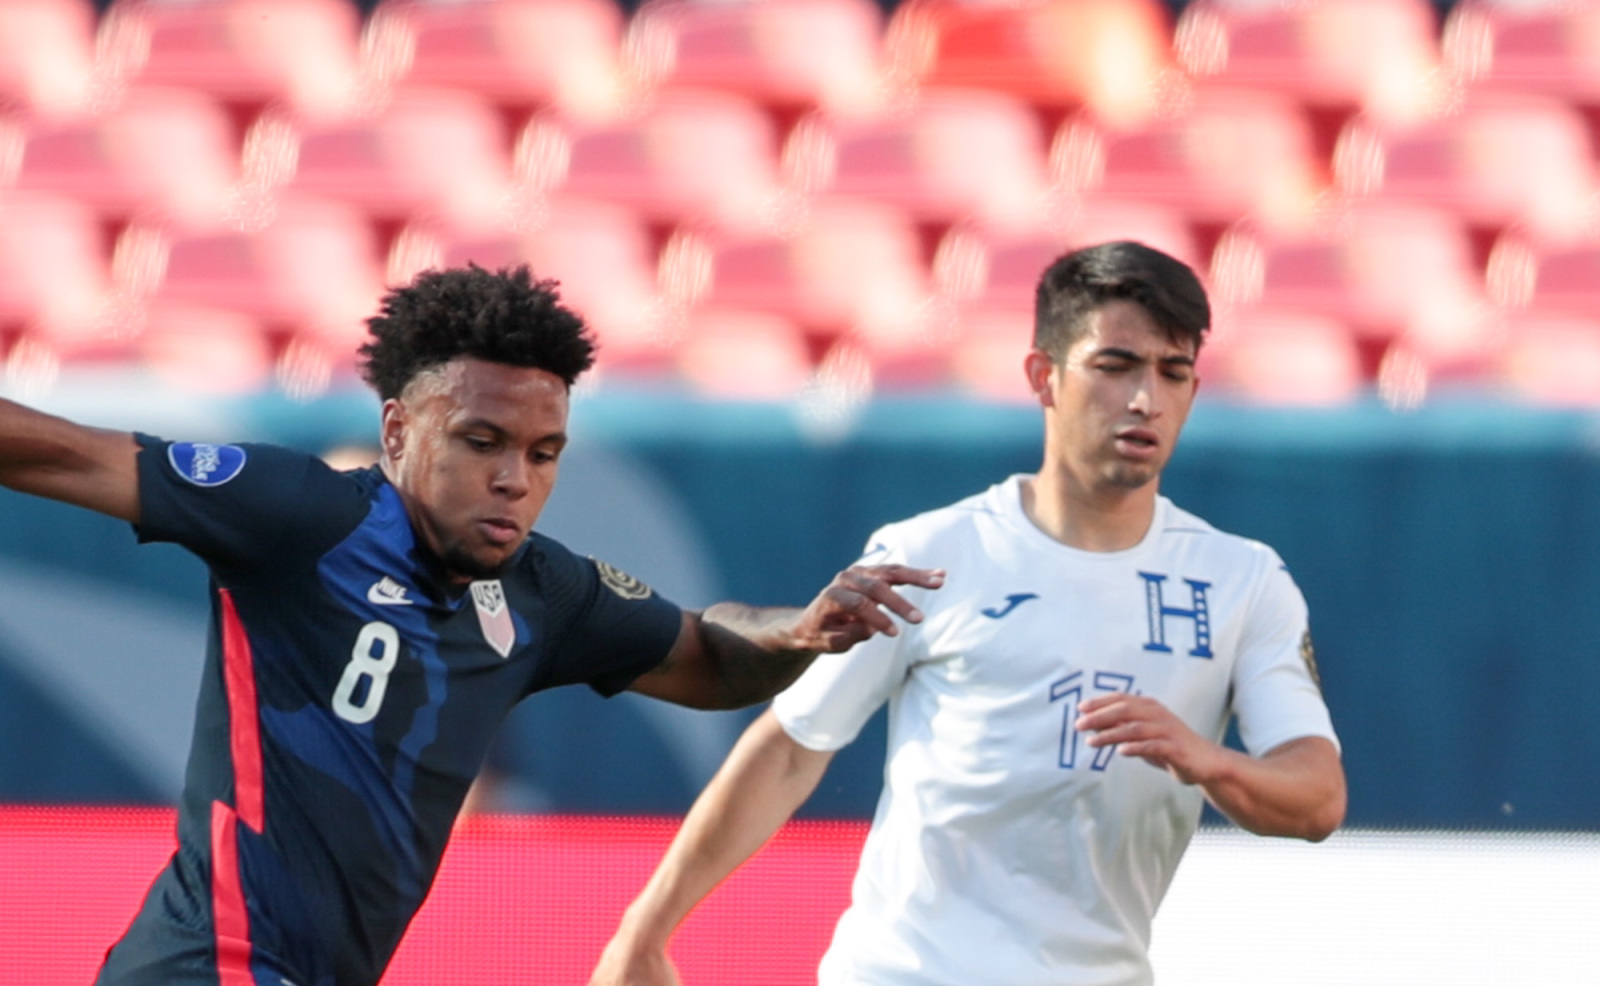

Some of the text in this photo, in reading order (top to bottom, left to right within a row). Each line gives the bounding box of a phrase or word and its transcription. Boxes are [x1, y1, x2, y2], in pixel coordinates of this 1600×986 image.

[473, 583, 502, 612] USA
[1137, 570, 1213, 660] H
[331, 620, 400, 724] 8
[1049, 669, 1135, 773] 17
